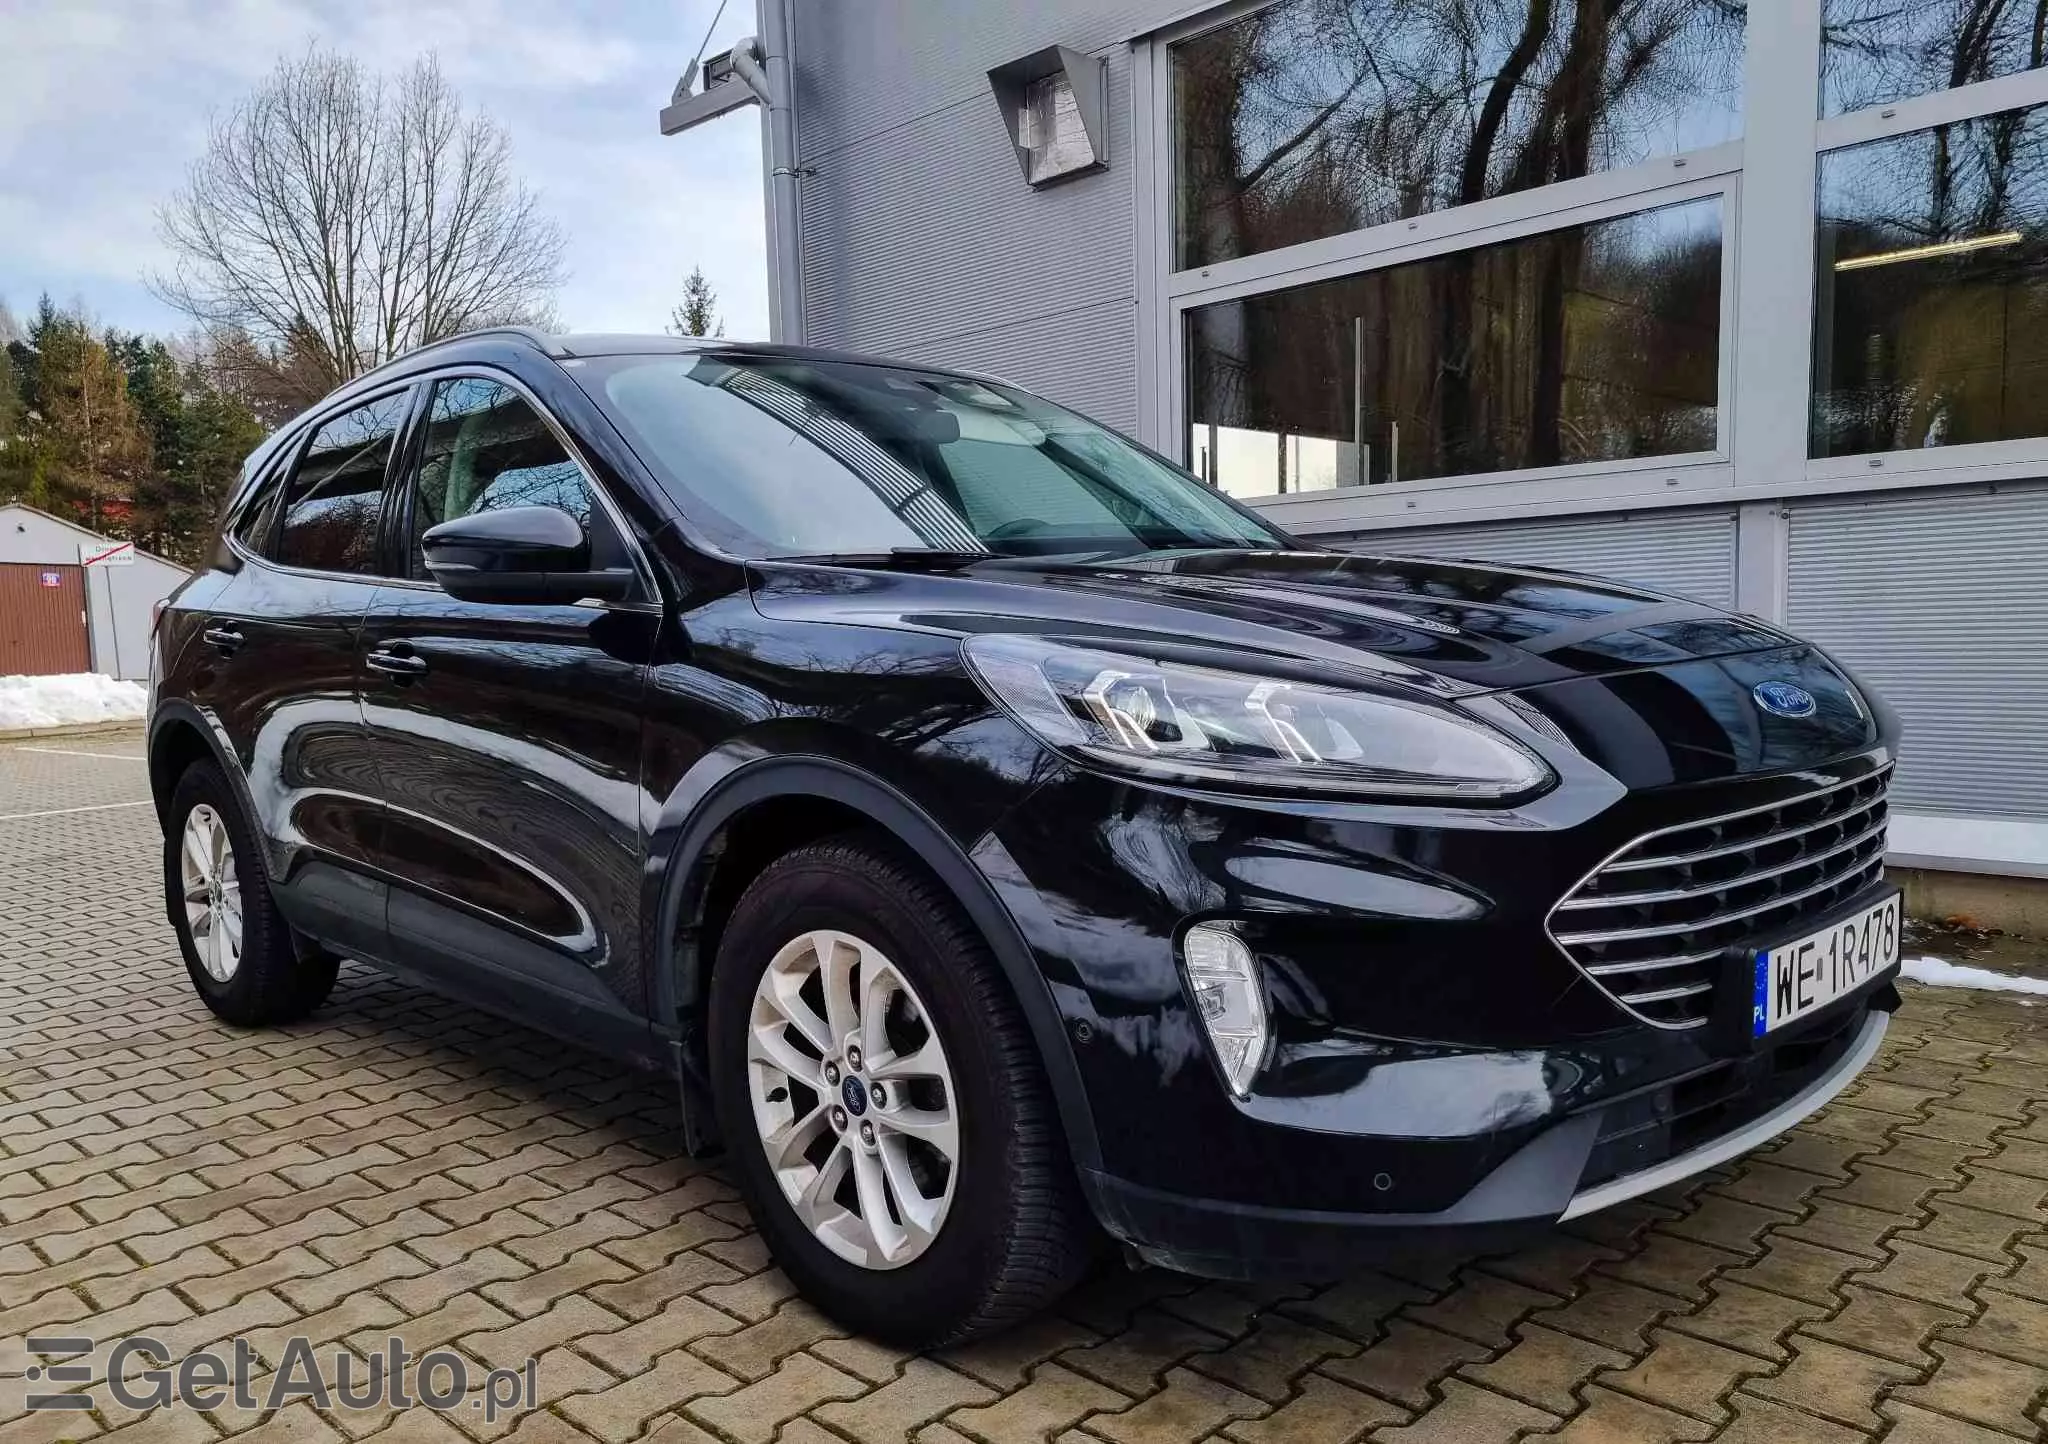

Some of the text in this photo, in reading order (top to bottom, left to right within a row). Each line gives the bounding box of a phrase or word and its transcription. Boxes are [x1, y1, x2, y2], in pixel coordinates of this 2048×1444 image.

[1768, 687, 1809, 708] Ford
[1777, 903, 1895, 1019] WE 1R478
[1753, 1006, 1765, 1025] PL
